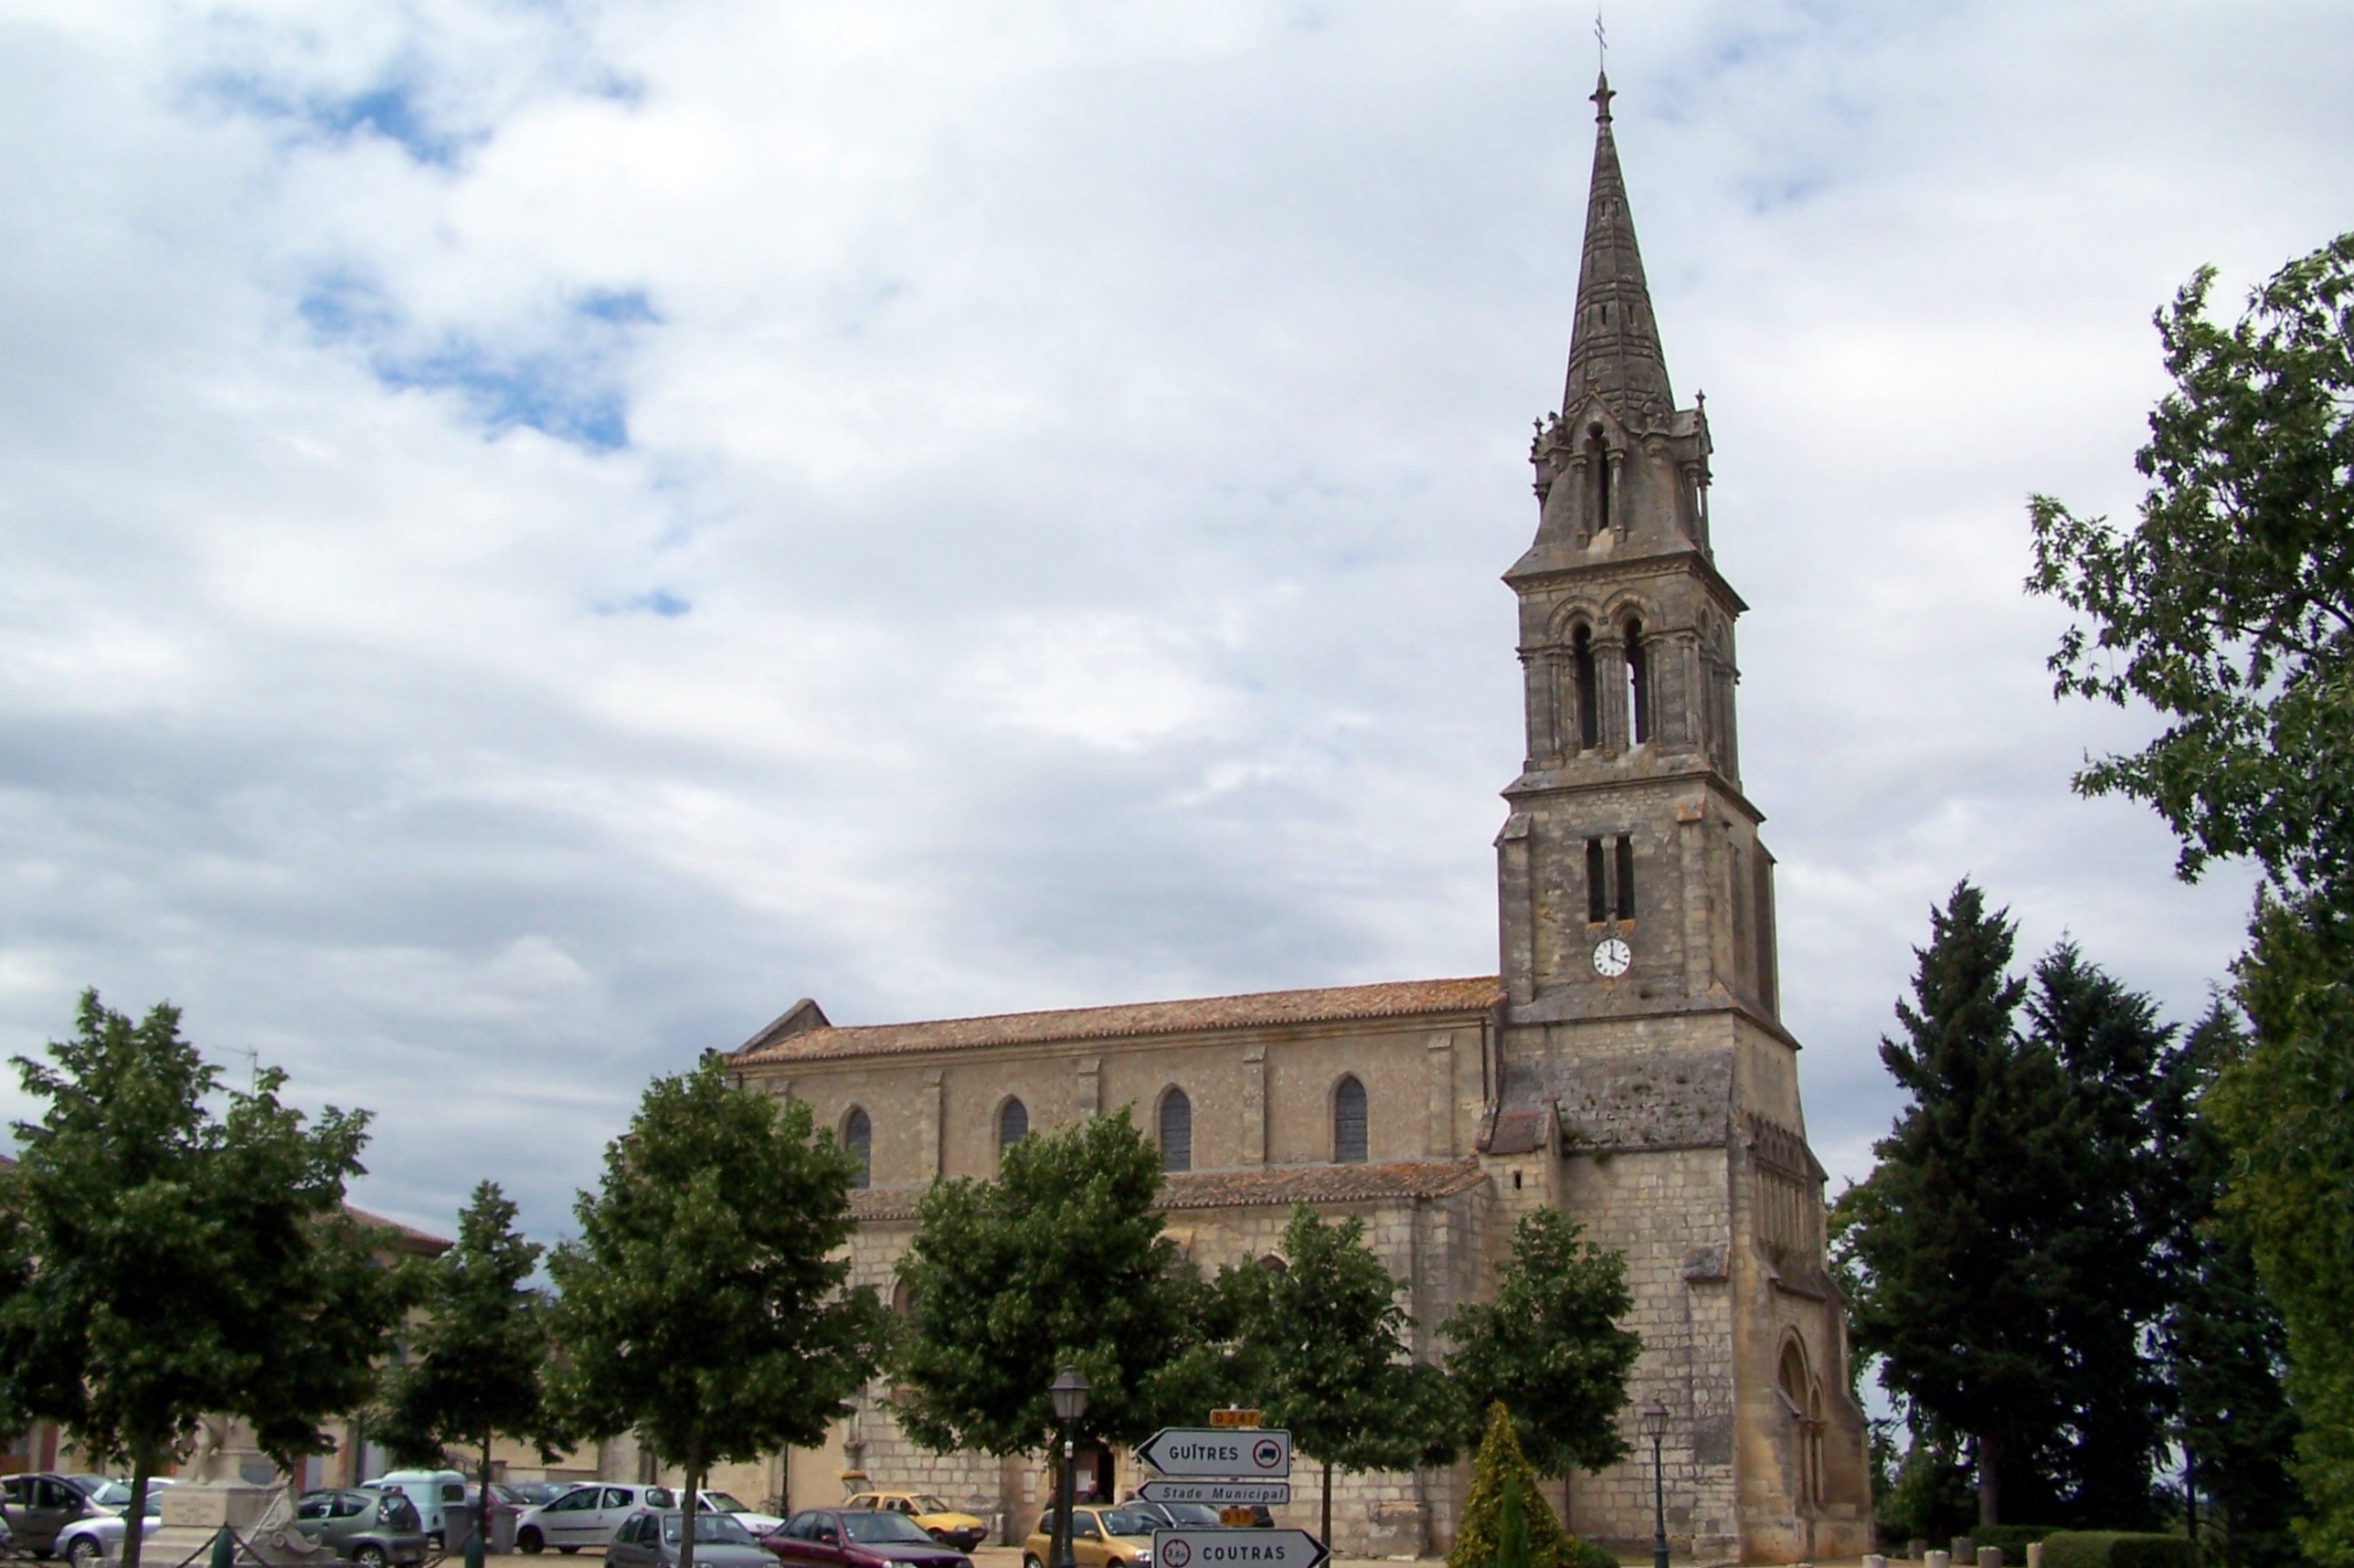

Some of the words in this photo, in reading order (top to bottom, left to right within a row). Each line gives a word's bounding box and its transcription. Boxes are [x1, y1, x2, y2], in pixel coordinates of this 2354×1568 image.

[1215, 1412, 1224, 1424] D
[1162, 1487, 1203, 1499] Stade
[1213, 1488, 1284, 1501] Municipal
[1203, 1546, 1285, 1560] COUTRAS
